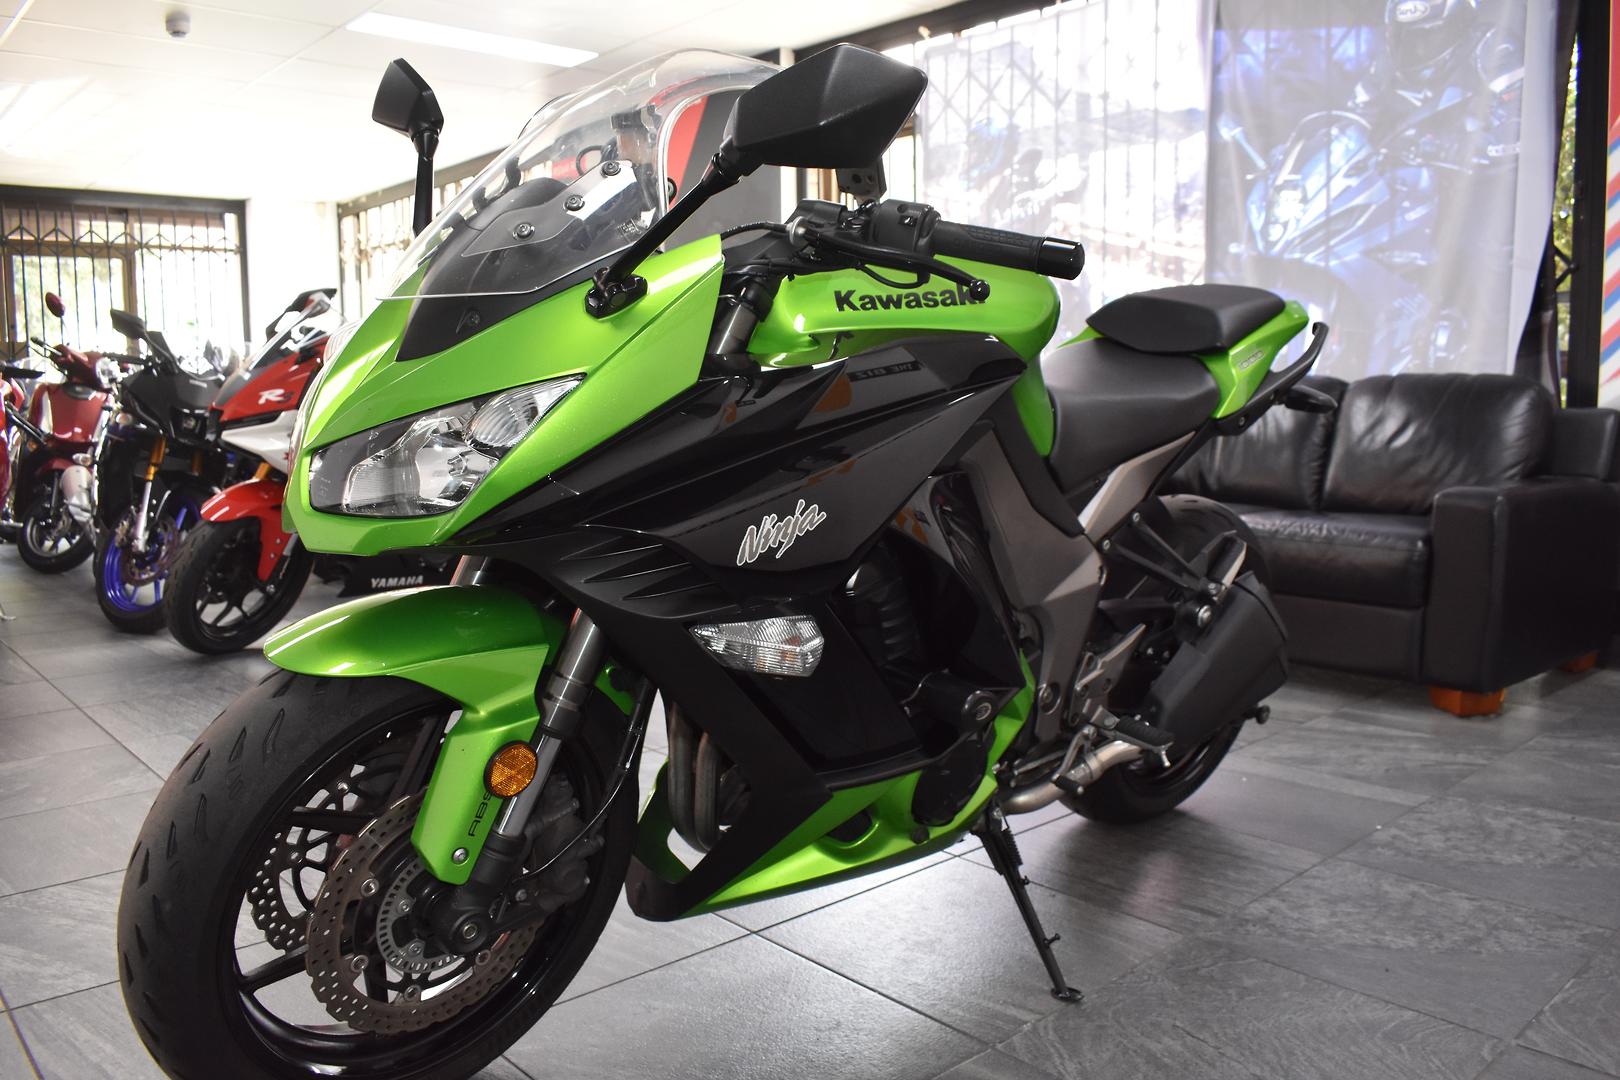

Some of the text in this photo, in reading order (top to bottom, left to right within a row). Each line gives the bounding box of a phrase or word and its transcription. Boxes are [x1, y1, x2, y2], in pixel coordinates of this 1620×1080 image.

[834, 282, 985, 312] Kawasak
[737, 498, 827, 566] Ninja
[370, 574, 424, 588] YAMAHA
